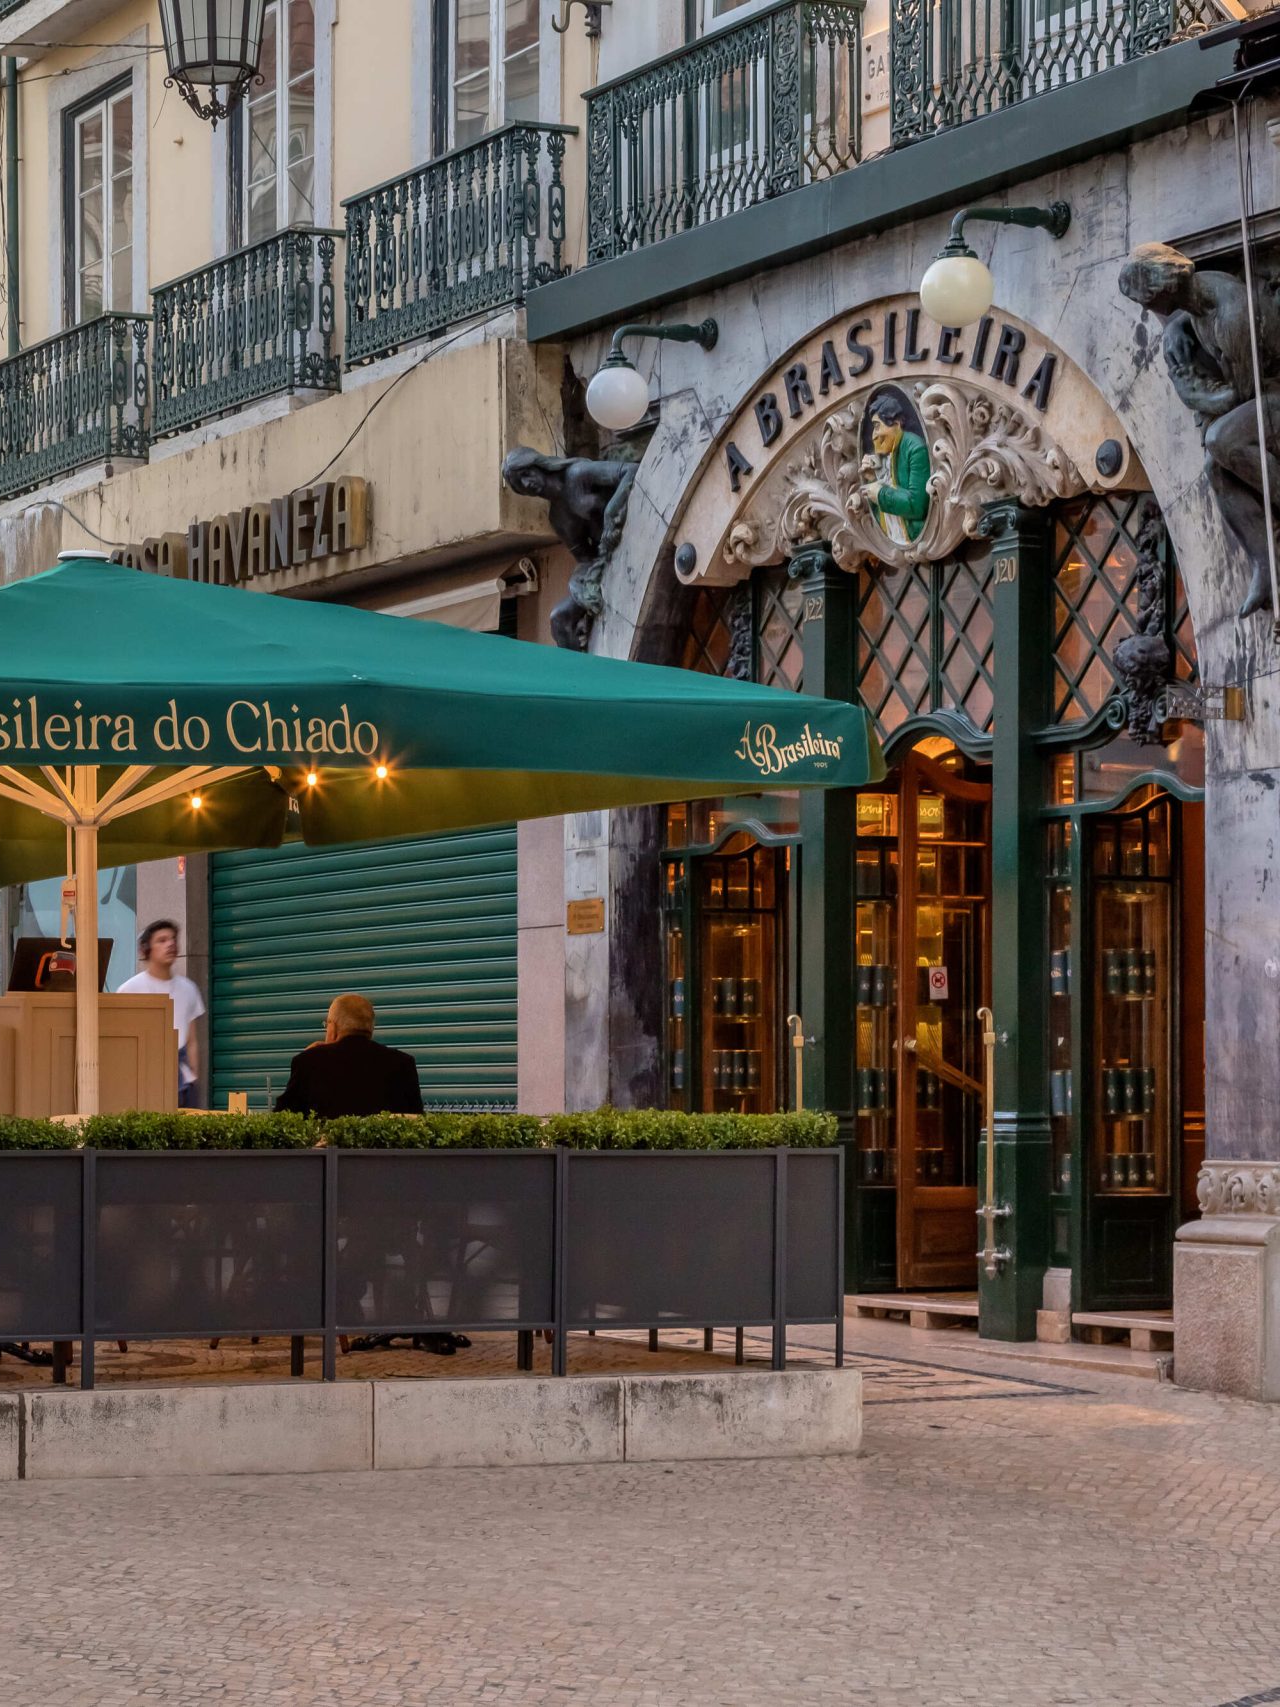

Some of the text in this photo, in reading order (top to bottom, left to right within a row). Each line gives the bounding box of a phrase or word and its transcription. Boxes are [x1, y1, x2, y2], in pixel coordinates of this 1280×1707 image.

[725, 308, 1057, 492] A BRASILEIRA
[188, 475, 367, 587] HAVANEZA
[994, 556, 1017, 584] 120
[804, 597, 824, 623] 122
[153, 698, 211, 751] do
[226, 700, 379, 756] Chiado
[756, 723, 841, 775] Brasileira
